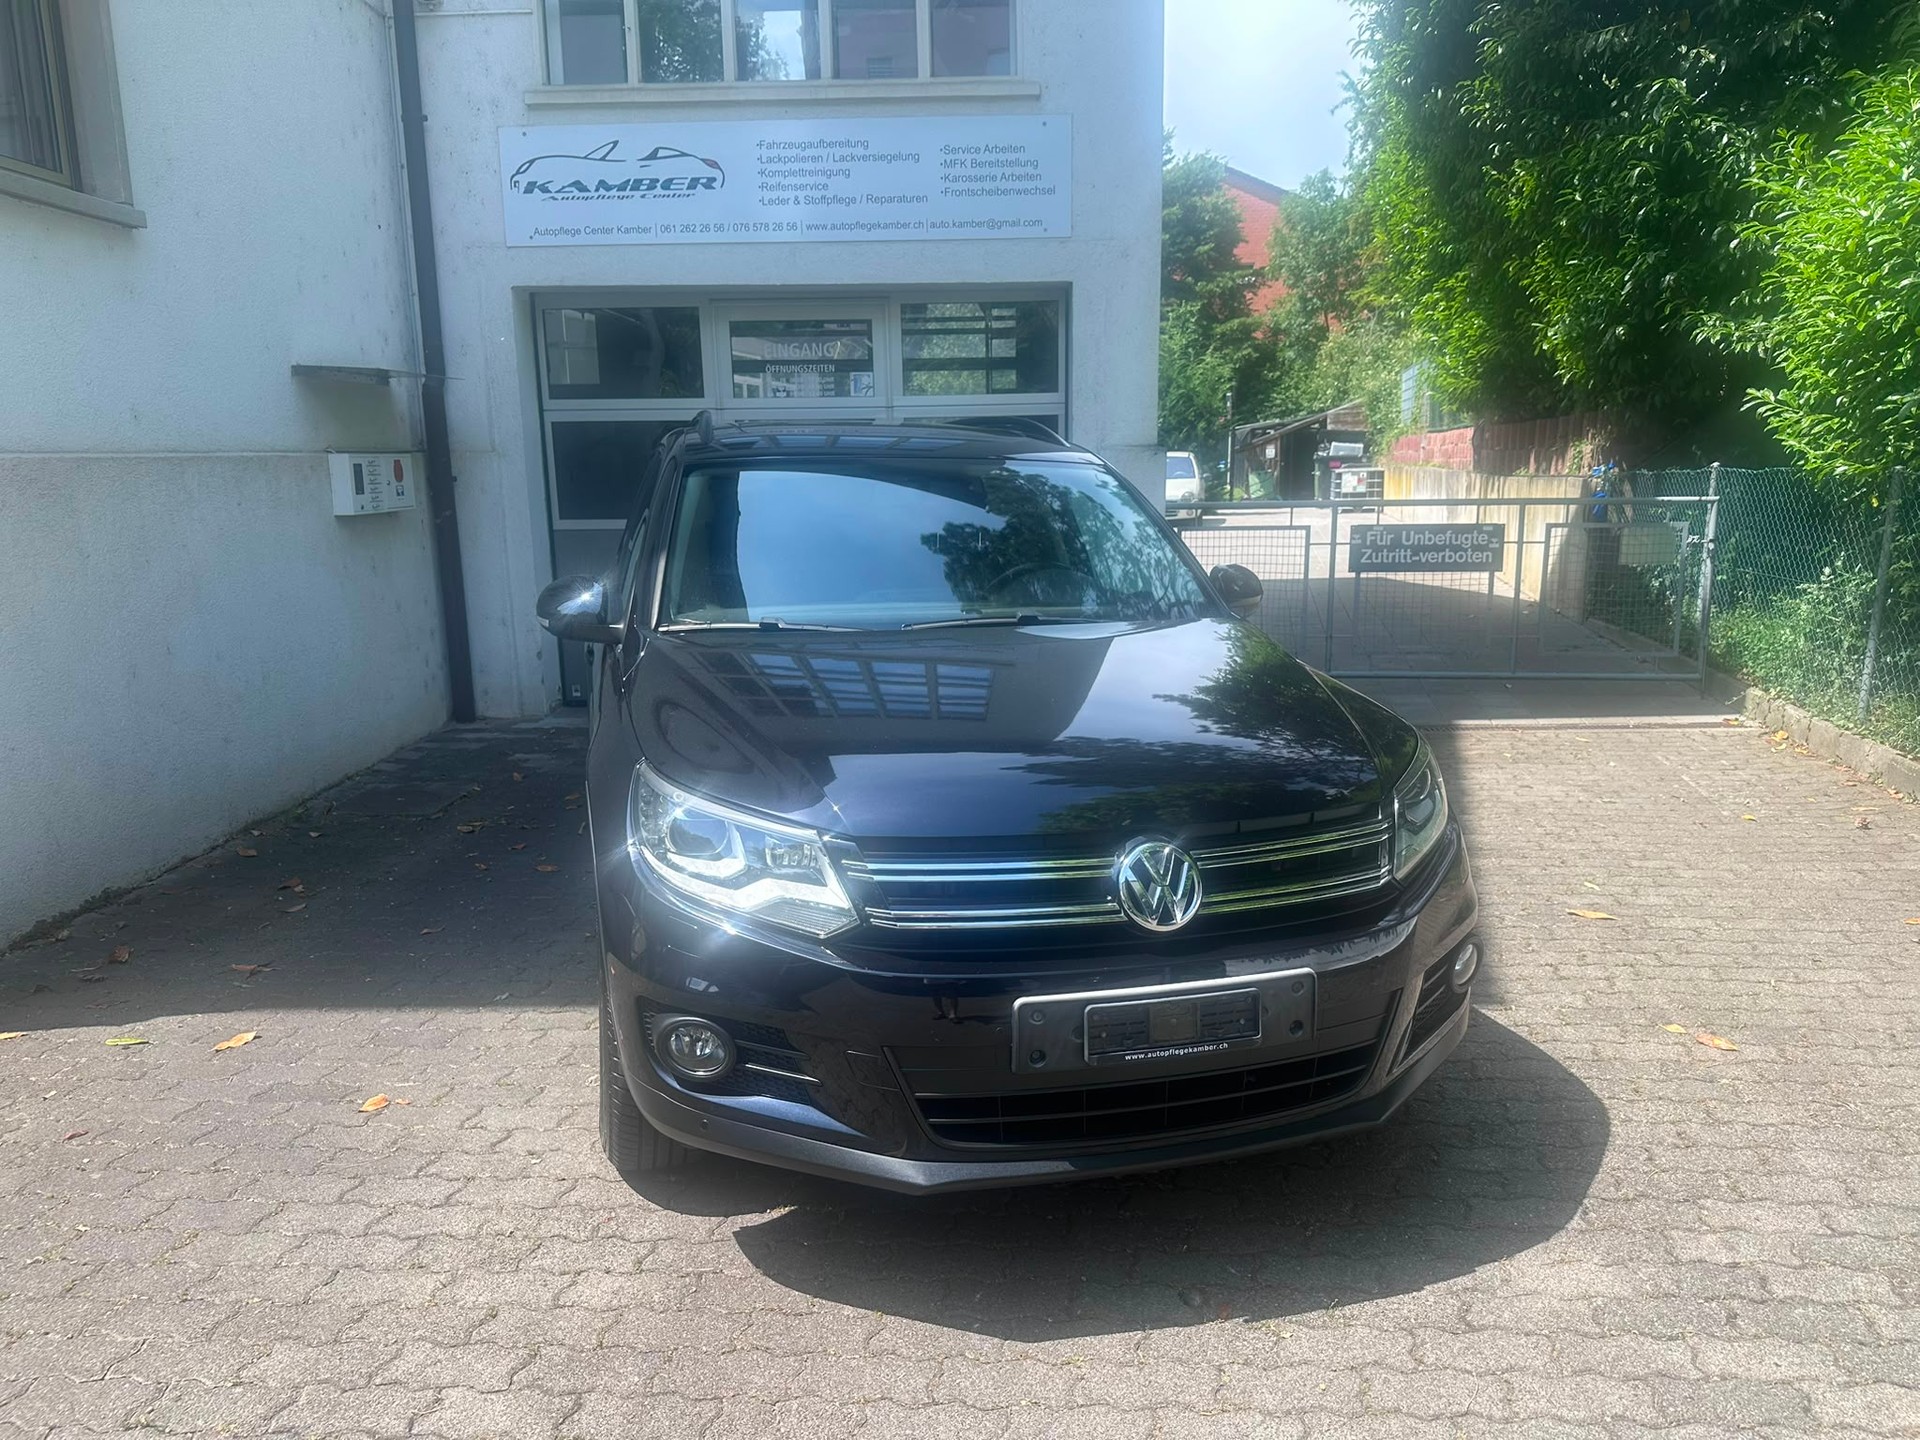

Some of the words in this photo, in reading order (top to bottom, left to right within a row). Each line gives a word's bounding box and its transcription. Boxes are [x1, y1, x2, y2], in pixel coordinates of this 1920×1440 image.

[758, 138, 870, 152] Fahrzeugaufbereitung
[943, 144, 982, 156] Service
[983, 143, 1026, 154] Arbeiten
[759, 153, 824, 166] Lackpolieren
[832, 151, 921, 164] Lackversiegelung
[943, 158, 968, 169] MFK
[970, 157, 1040, 170] Bereitstellung
[760, 167, 851, 180] Komplettreinigung
[943, 172, 998, 184] Karosserie
[1000, 171, 1042, 182] Arbeiten
[523, 176, 717, 194] KAMBER
[760, 181, 829, 193] Reifenservice
[944, 185, 1056, 198] Frontscheibenwechsel
[761, 195, 791, 207] Leder
[793, 195, 801, 206] &
[803, 194, 857, 207] Stoffpflege
[866, 193, 929, 206] Reparaturen
[533, 226, 582, 238] Autopflege
[583, 225, 615, 236] Center
[616, 224, 652, 235] Kamber
[660, 224, 677, 234] 061
[679, 223, 697, 234] 262
[699, 223, 711, 233] 26
[713, 223, 725, 233] 56
[732, 222, 751, 233] 076
[752, 222, 770, 233] 578
[772, 222, 784, 233] 26
[786, 221, 798, 232] 56
[806, 220, 925, 233] www.autopflegekamber.ch
[929, 218, 1043, 230] auto.kamber@gmail.com
[765, 342, 834, 358] EINGANG
[765, 363, 836, 373] ÖFFNUNGSZEITEN
[1366, 530, 1395, 546] Für
[1402, 530, 1488, 548] Unbefugte
[1360, 549, 1493, 563] Zutritt-verboten
[1124, 1042, 1229, 1061] www.autopflegekamber.ch
